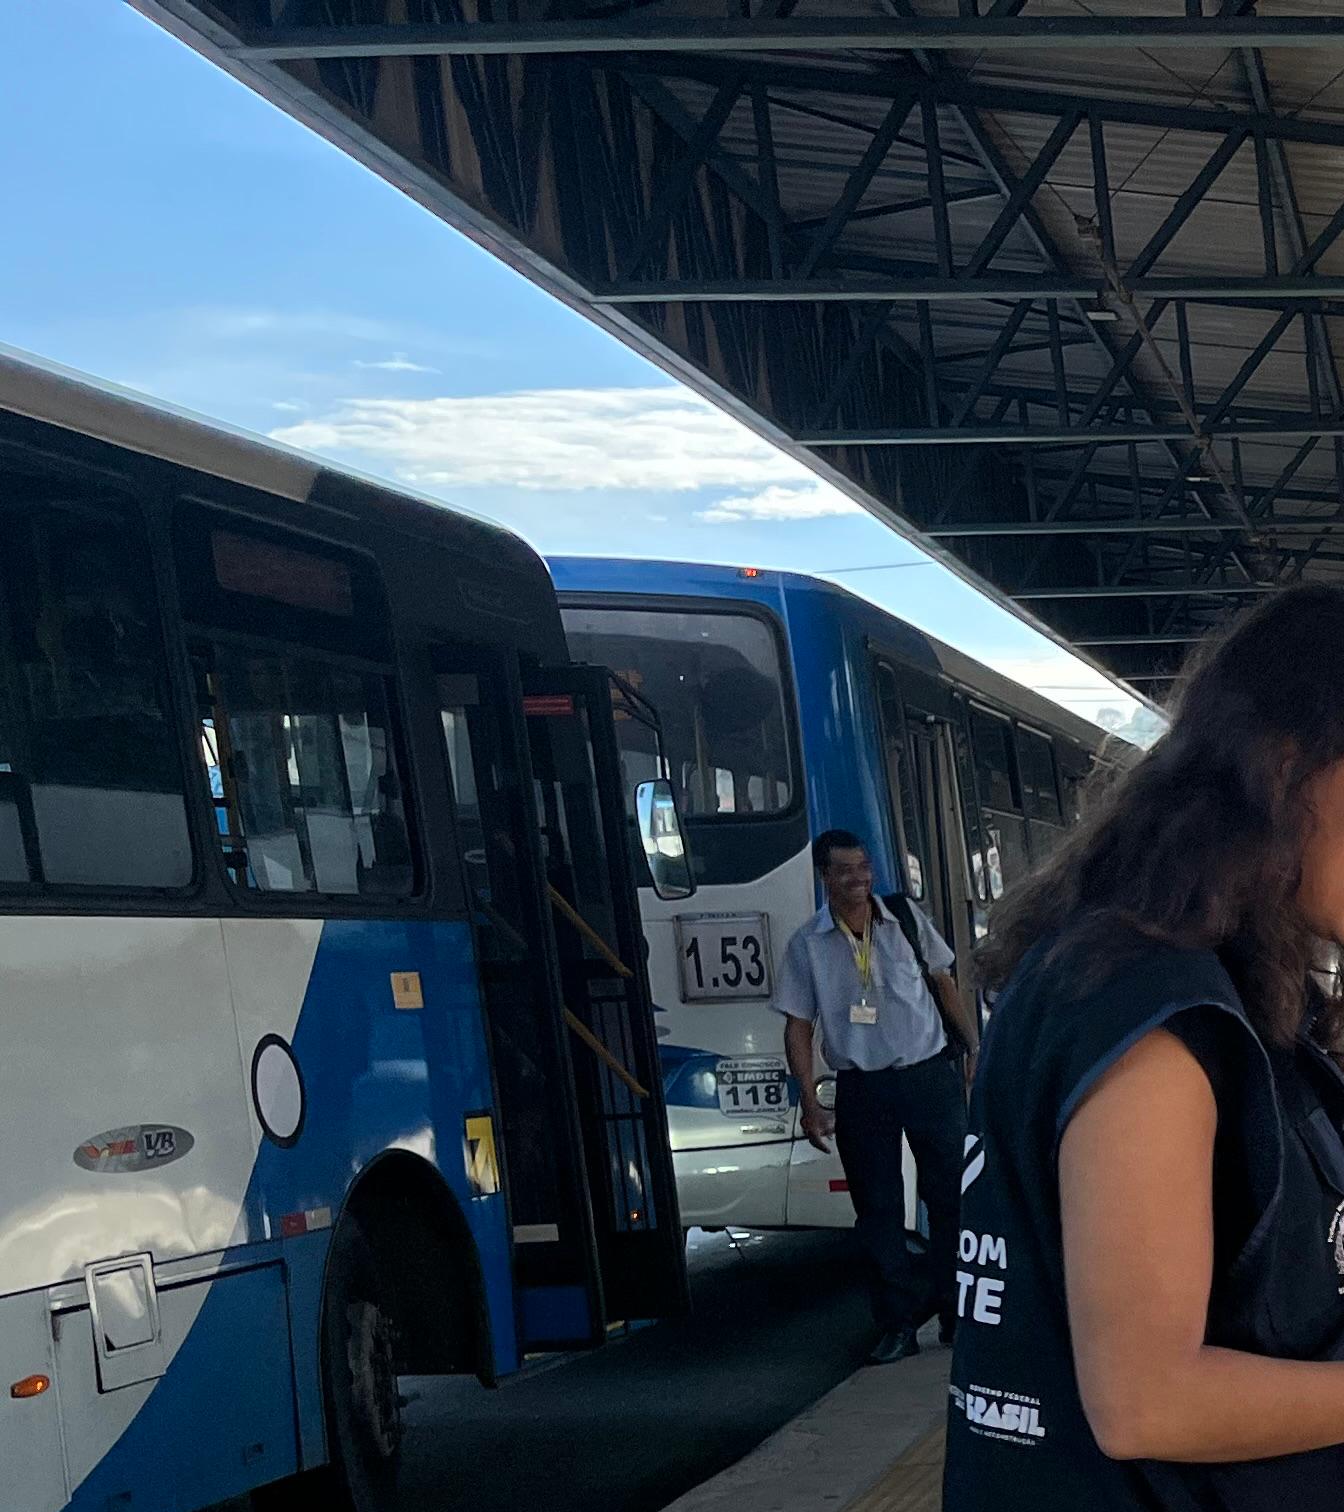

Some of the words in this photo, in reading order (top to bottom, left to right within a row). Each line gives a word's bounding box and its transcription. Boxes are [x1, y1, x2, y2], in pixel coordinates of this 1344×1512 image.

[685, 935, 765, 988] 1.53
[736, 1071, 780, 1081] EMDEC
[726, 1085, 782, 1106] 118
